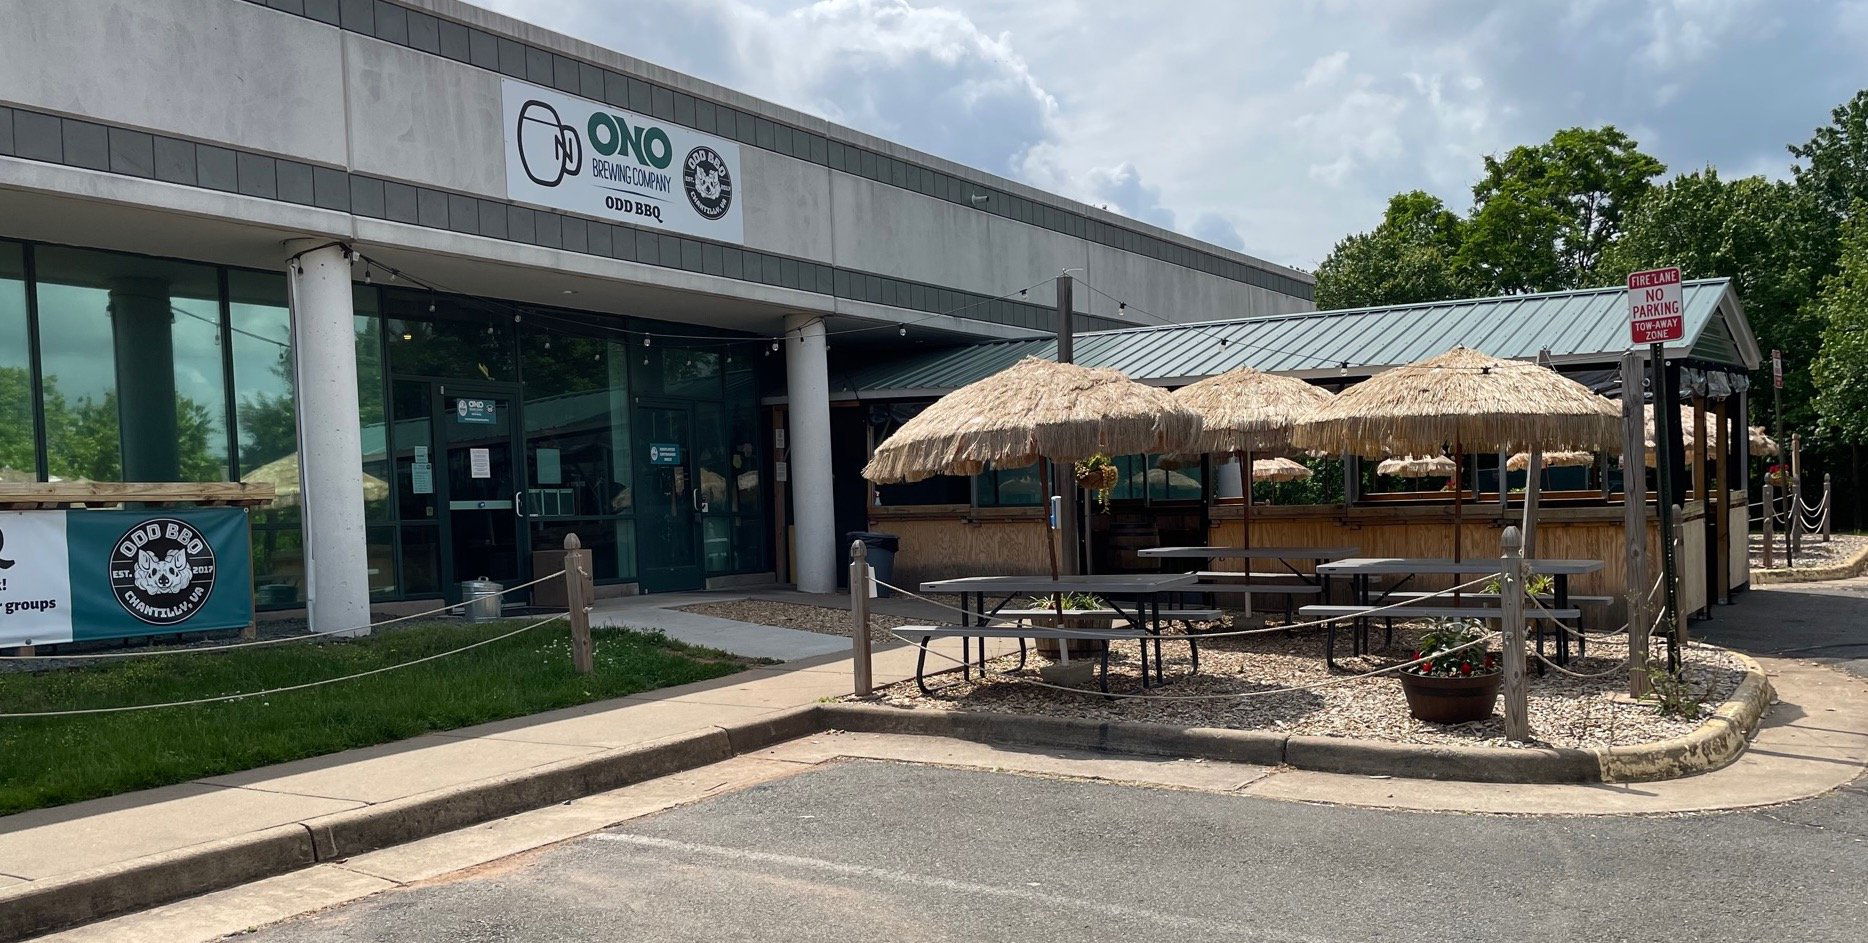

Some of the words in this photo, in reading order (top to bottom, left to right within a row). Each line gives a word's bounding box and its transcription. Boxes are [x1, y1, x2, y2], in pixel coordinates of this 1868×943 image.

[587, 111, 672, 169] ONO
[688, 150, 706, 169] ODD
[592, 158, 632, 184] BREWING
[633, 169, 672, 193] COMPANY
[605, 195, 633, 213] ODD
[635, 204, 663, 223] BBQ
[1631, 274, 1651, 287] FIRE
[1653, 270, 1677, 284] LANE
[1645, 288, 1664, 302] NO
[1633, 300, 1679, 319] PARKING
[1635, 318, 1678, 331] TOW-AWAY
[1645, 329, 1669, 340] ZONE
[119, 523, 161, 558] ODD
[165, 523, 204, 556] BBQ
[112, 569, 133, 579] EST.
[192, 565, 214, 575] 2017
[192, 586, 205, 603] VA
[5, 599, 56, 615] groups
